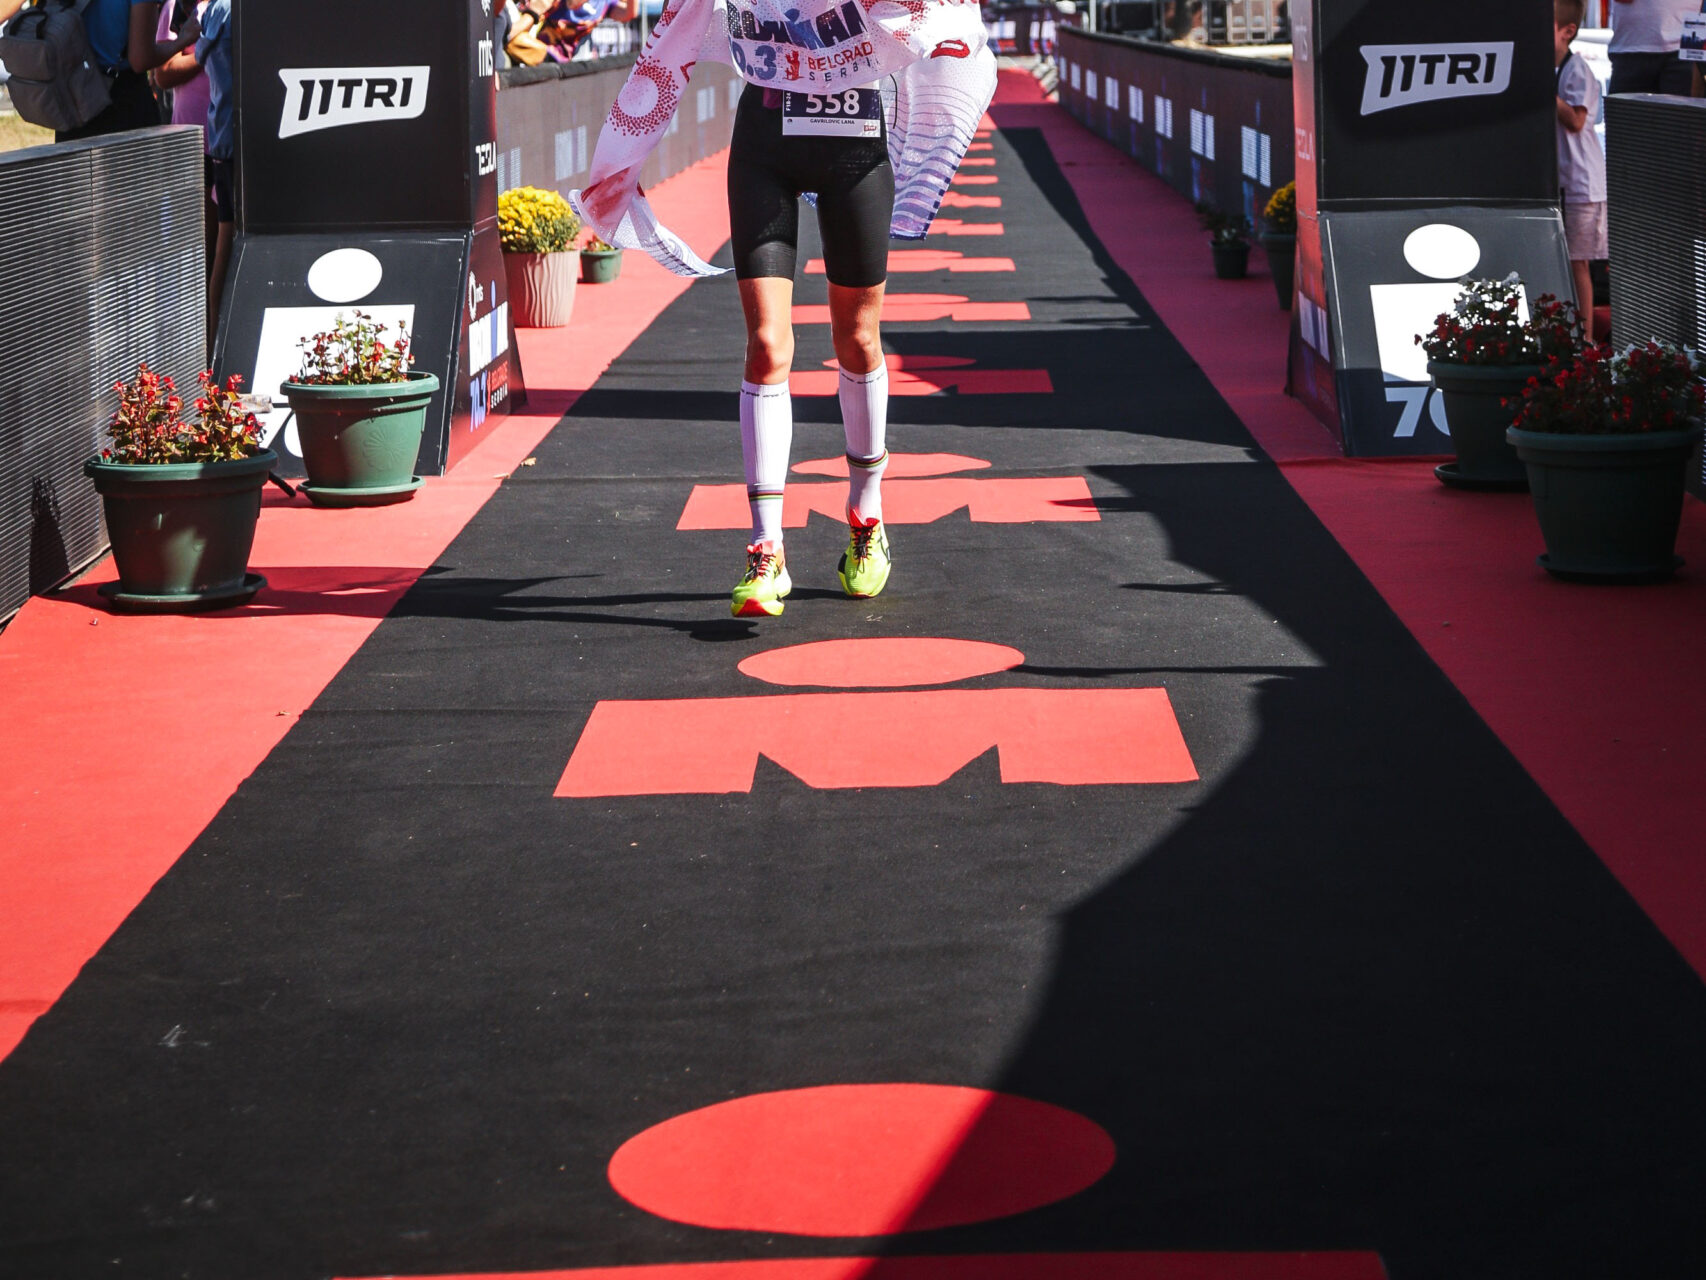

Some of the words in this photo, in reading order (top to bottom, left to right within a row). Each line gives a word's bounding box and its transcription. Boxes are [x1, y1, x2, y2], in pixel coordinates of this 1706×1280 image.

[807, 41, 873, 72] BELGRAD
[808, 56, 880, 82] SERBI
[805, 89, 860, 115] 558
